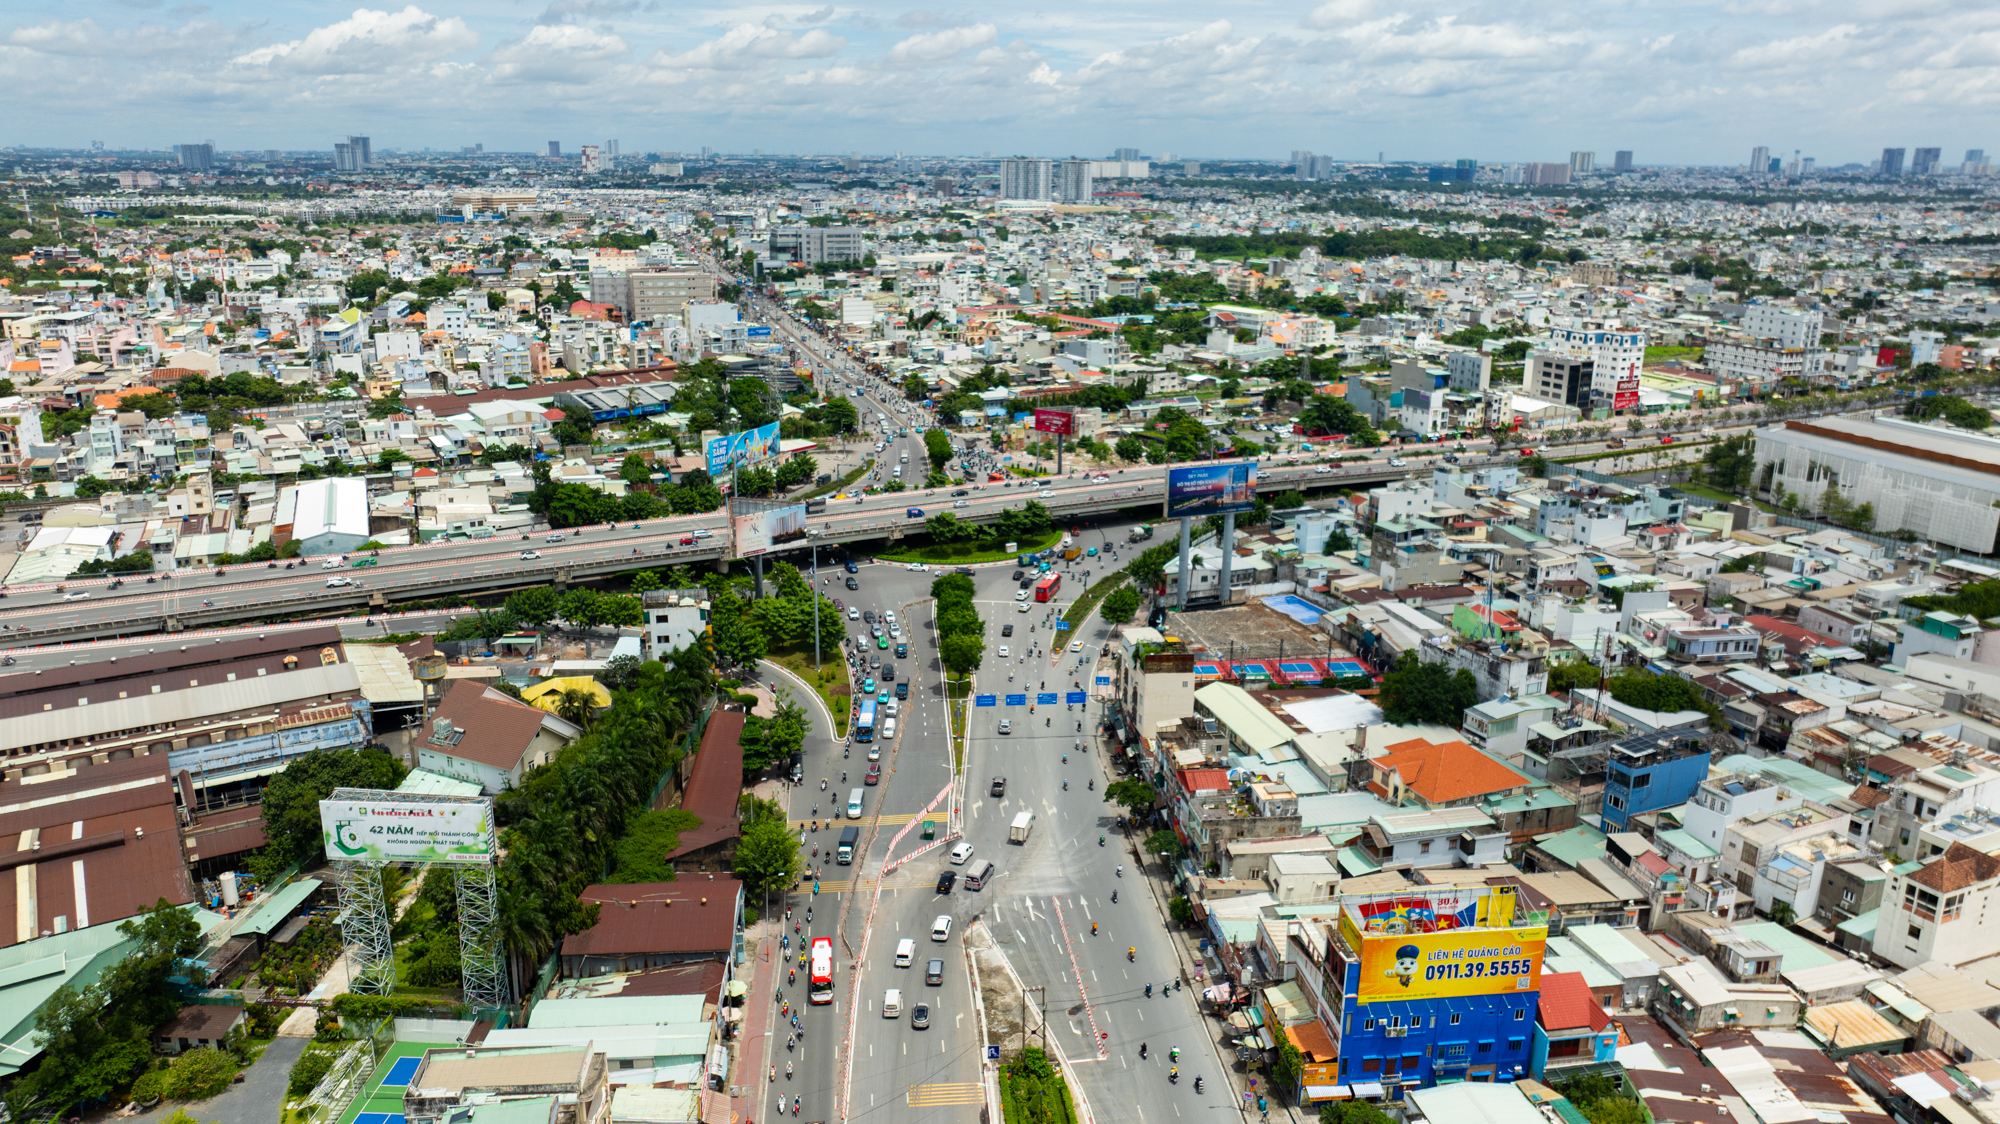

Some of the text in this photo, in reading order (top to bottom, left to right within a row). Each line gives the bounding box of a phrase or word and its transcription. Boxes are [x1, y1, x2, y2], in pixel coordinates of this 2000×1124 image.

[369, 825, 384, 834] 42
[386, 824, 414, 835] NĂM
[1427, 944, 1522, 961] LIÊN HỆ QUẢNG CÁO
[1425, 958, 1532, 981] 0911.39.5555
